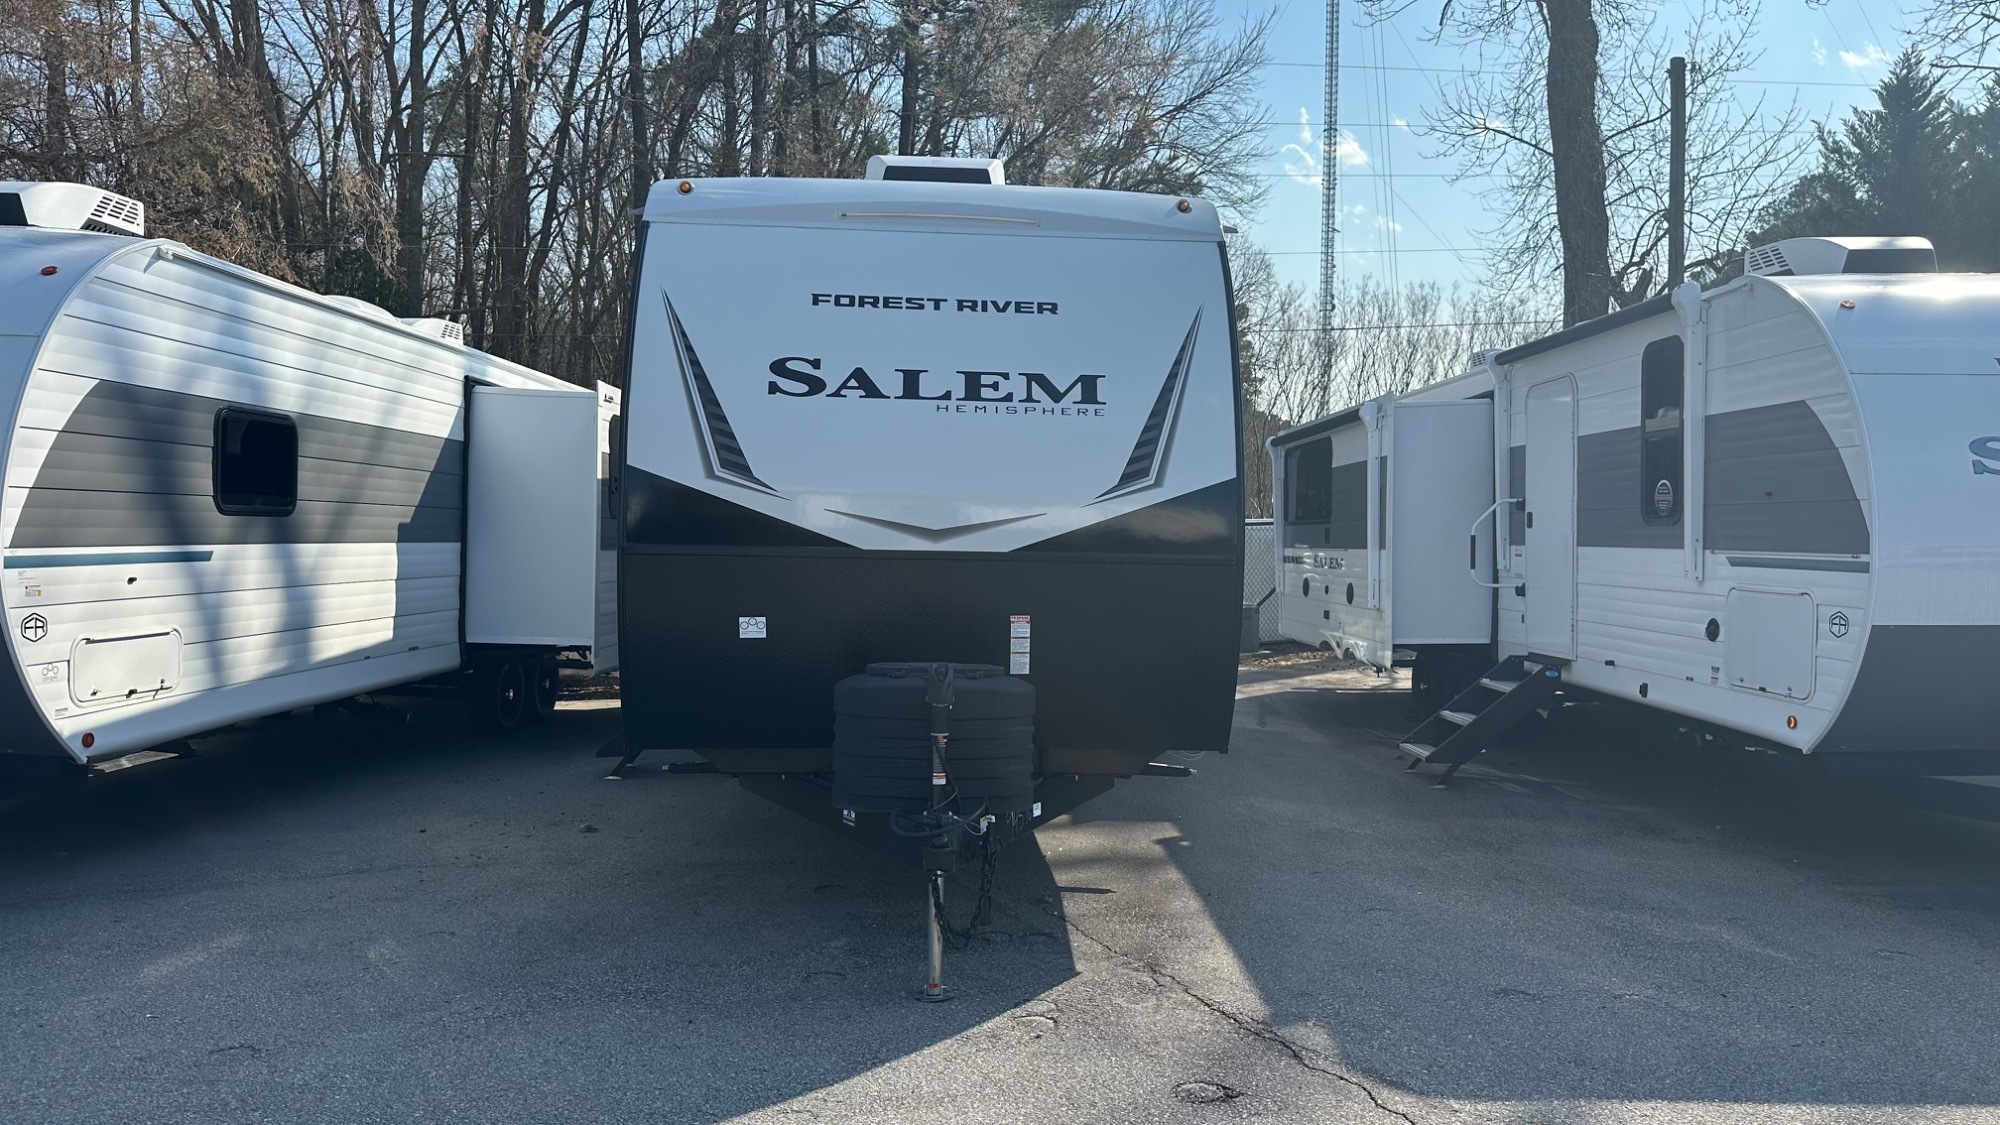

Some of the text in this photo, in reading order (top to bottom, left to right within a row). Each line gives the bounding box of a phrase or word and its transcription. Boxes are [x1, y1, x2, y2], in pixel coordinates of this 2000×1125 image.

[811, 293, 1059, 315] FOREST RIVER
[767, 356, 1107, 405] SALEM
[936, 404, 1105, 417] HEMISPHERE
